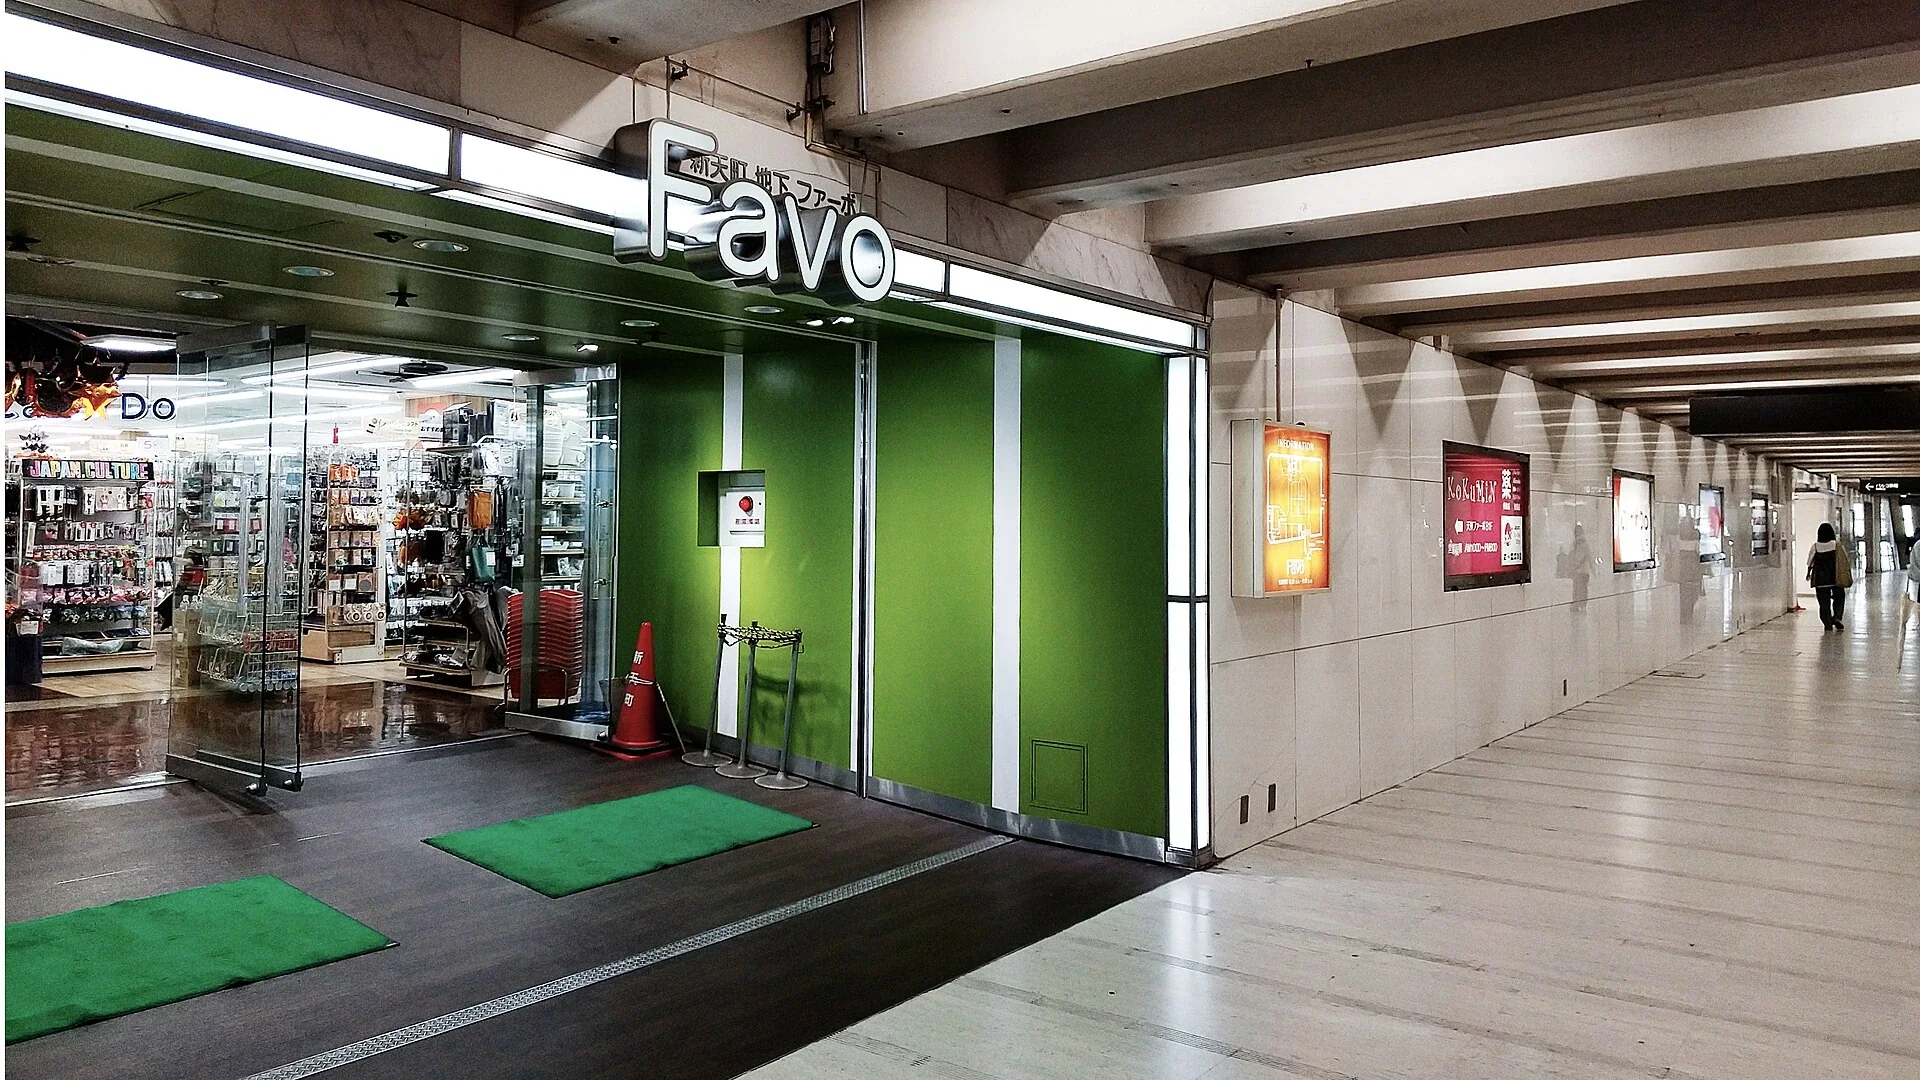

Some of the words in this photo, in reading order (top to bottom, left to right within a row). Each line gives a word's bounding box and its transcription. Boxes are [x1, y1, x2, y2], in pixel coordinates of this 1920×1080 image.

[690, 154, 748, 182] 新天町
[755, 165, 790, 195] 地下
[796, 180, 861, 216] ファーボ
[647, 118, 896, 302] Favo
[121, 392, 176, 420] Do
[1277, 438, 1315, 451] INFORMATION
